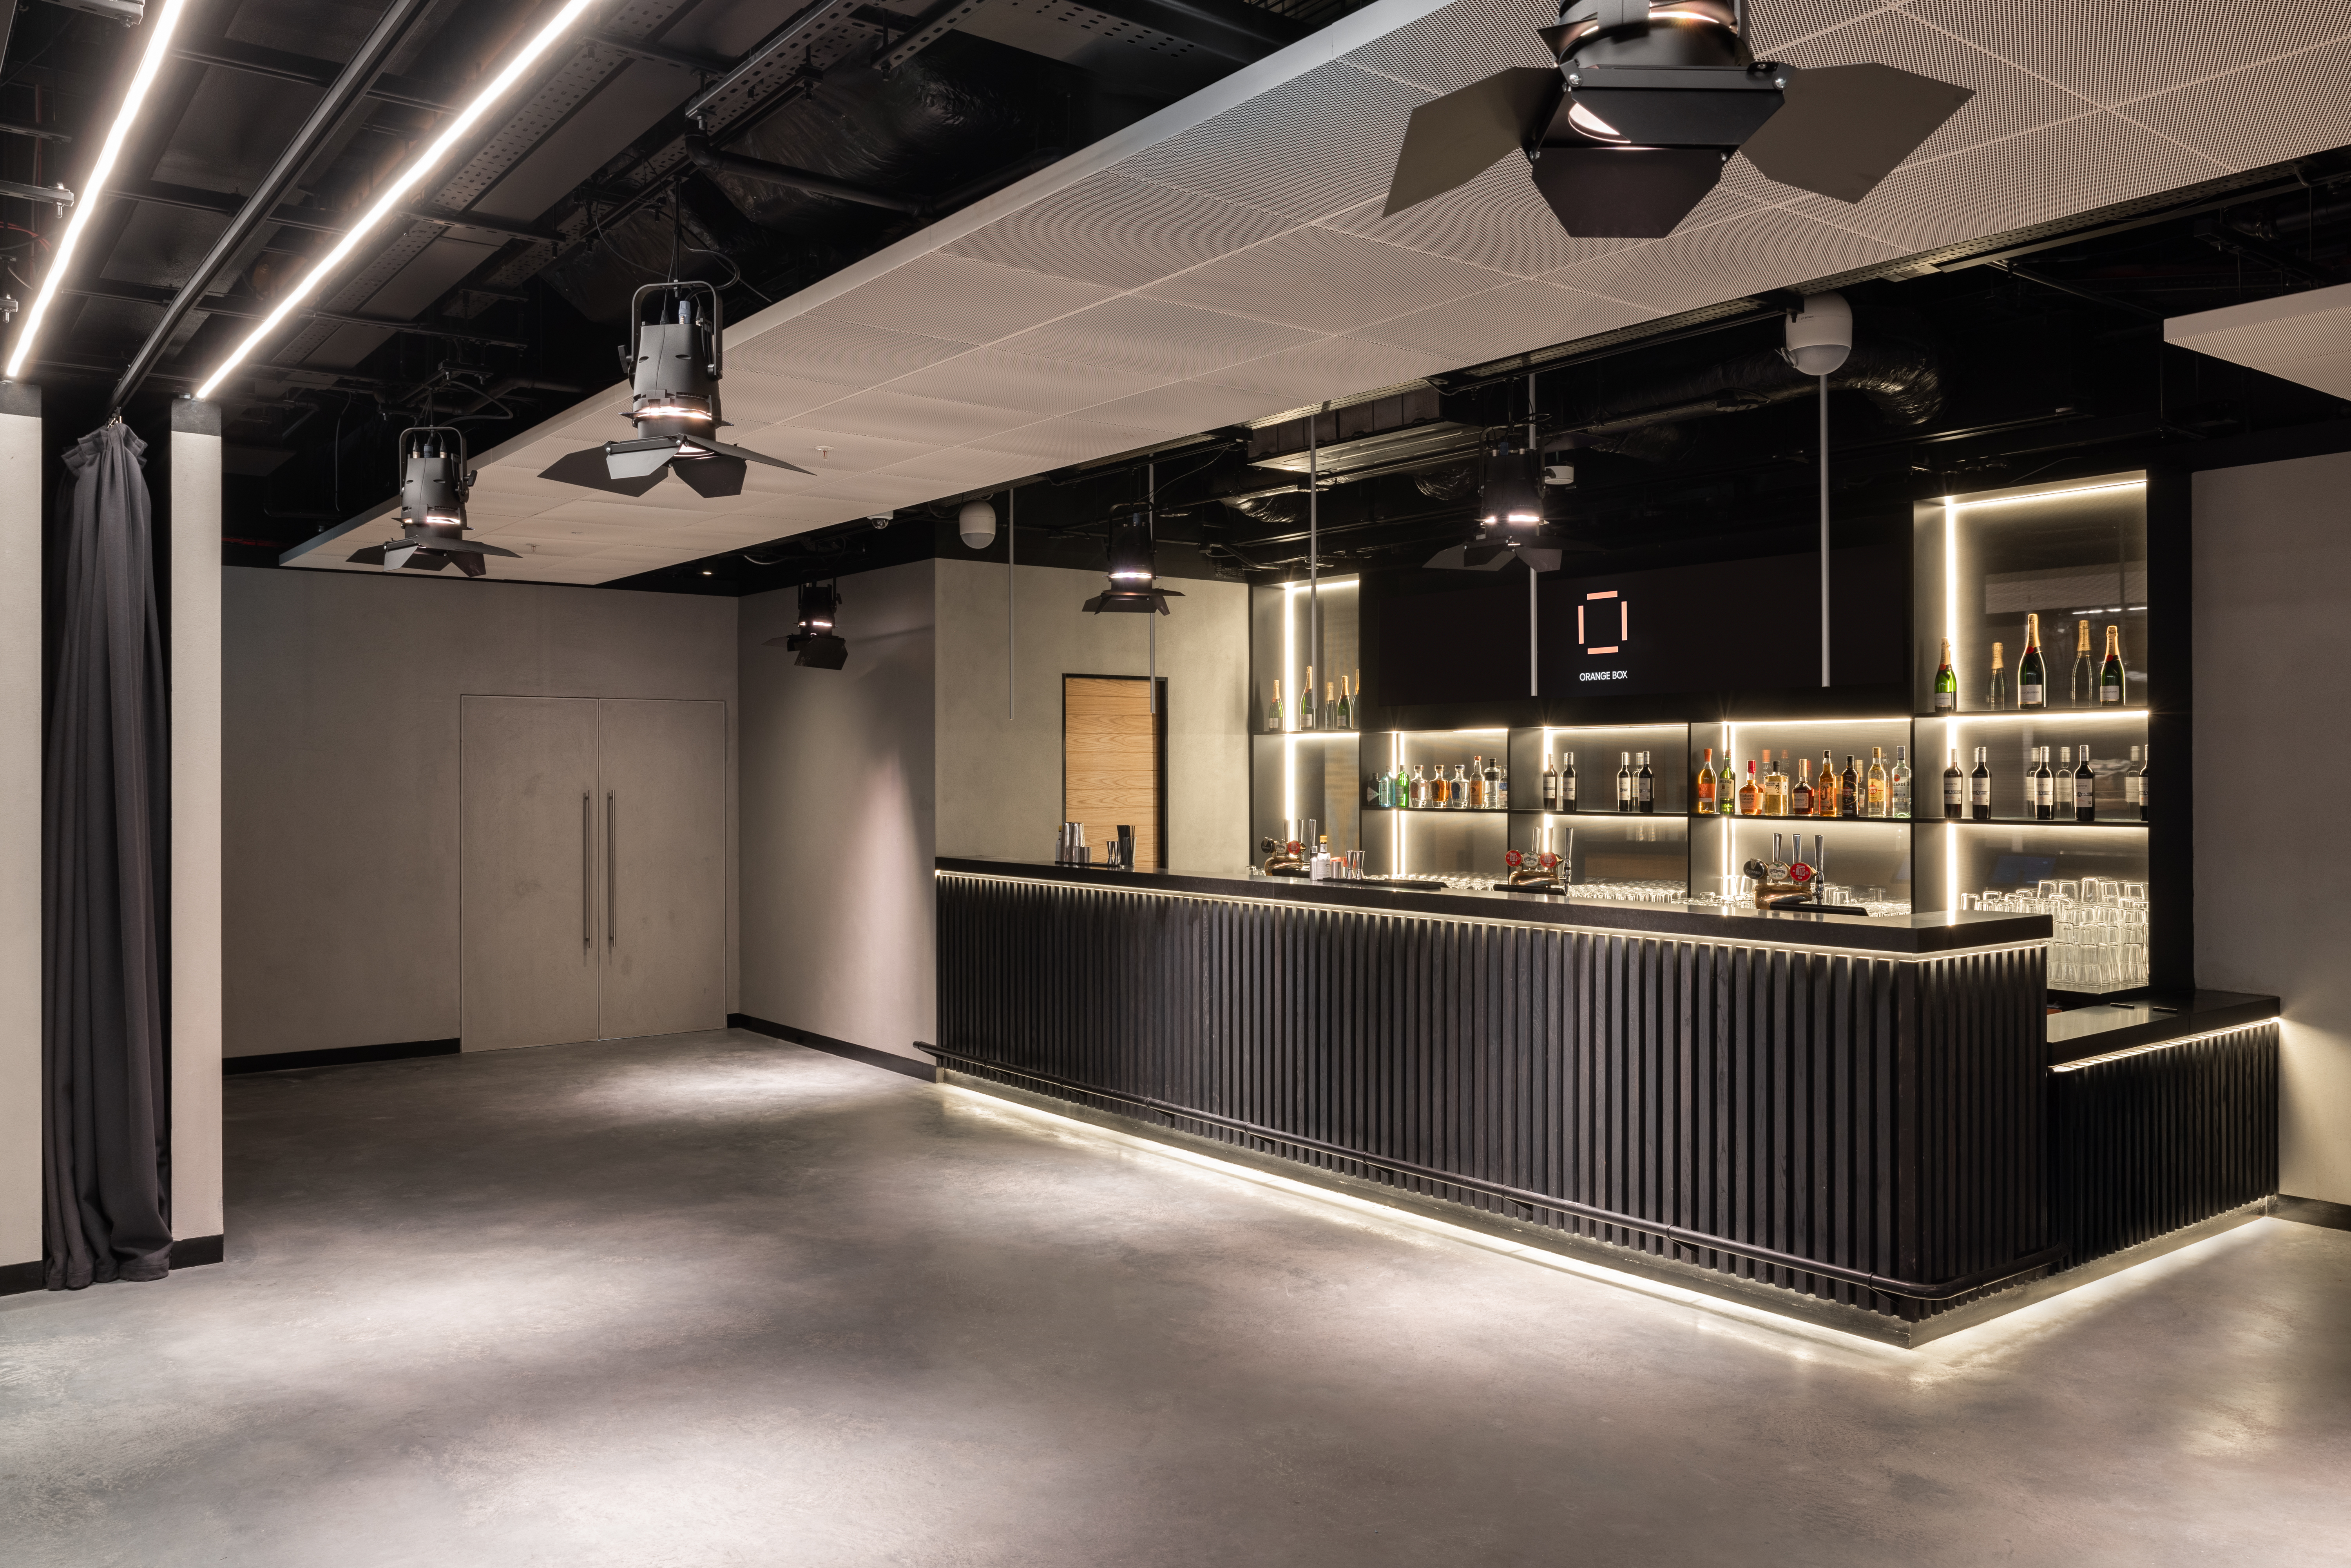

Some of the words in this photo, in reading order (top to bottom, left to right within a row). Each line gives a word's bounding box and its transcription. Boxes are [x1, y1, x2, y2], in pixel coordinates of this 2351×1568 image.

[1579, 672, 1610, 681] ORANGE
[1612, 671, 1628, 679] BOX
[1795, 867, 1806, 876] HELLS
